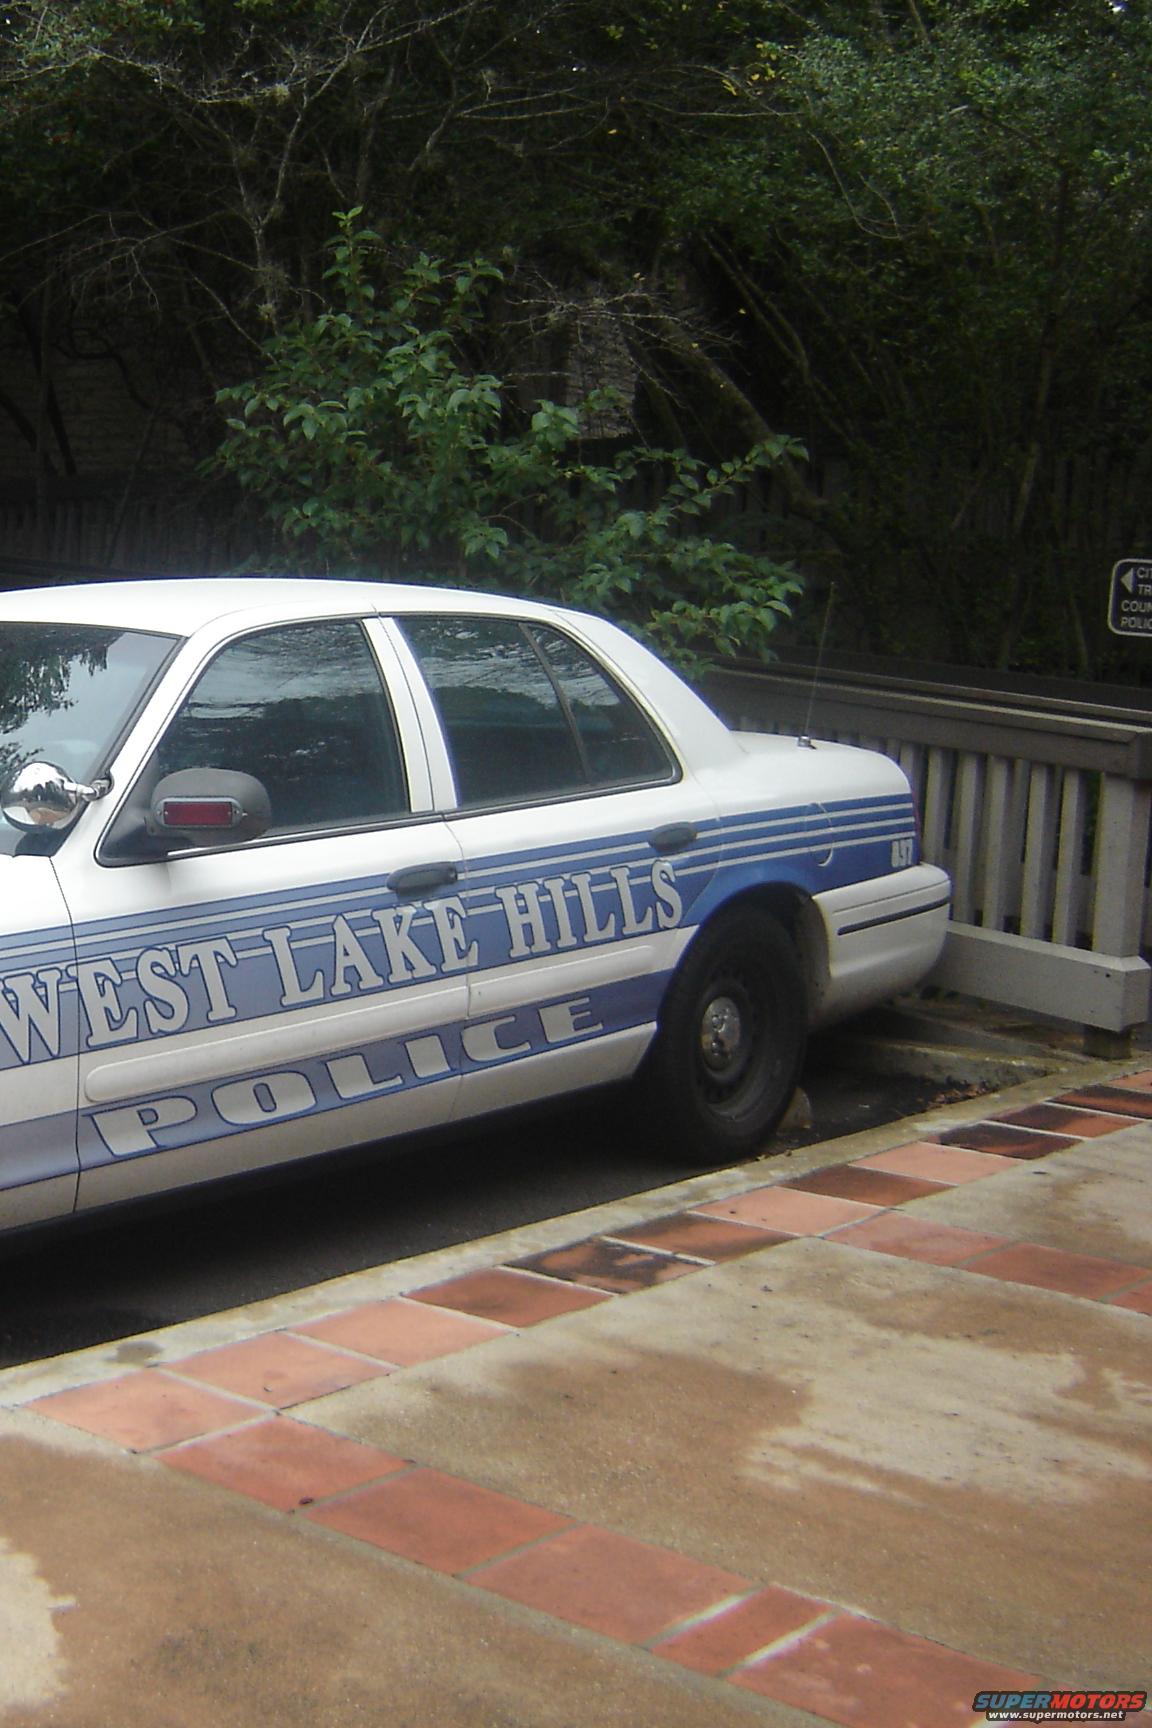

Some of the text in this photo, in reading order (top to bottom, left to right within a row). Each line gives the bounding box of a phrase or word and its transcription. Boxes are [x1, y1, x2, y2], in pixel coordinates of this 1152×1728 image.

[263, 894, 479, 1007] LAKE
[495, 859, 685, 959] HILLS
[84, 996, 604, 1157] POLICE
